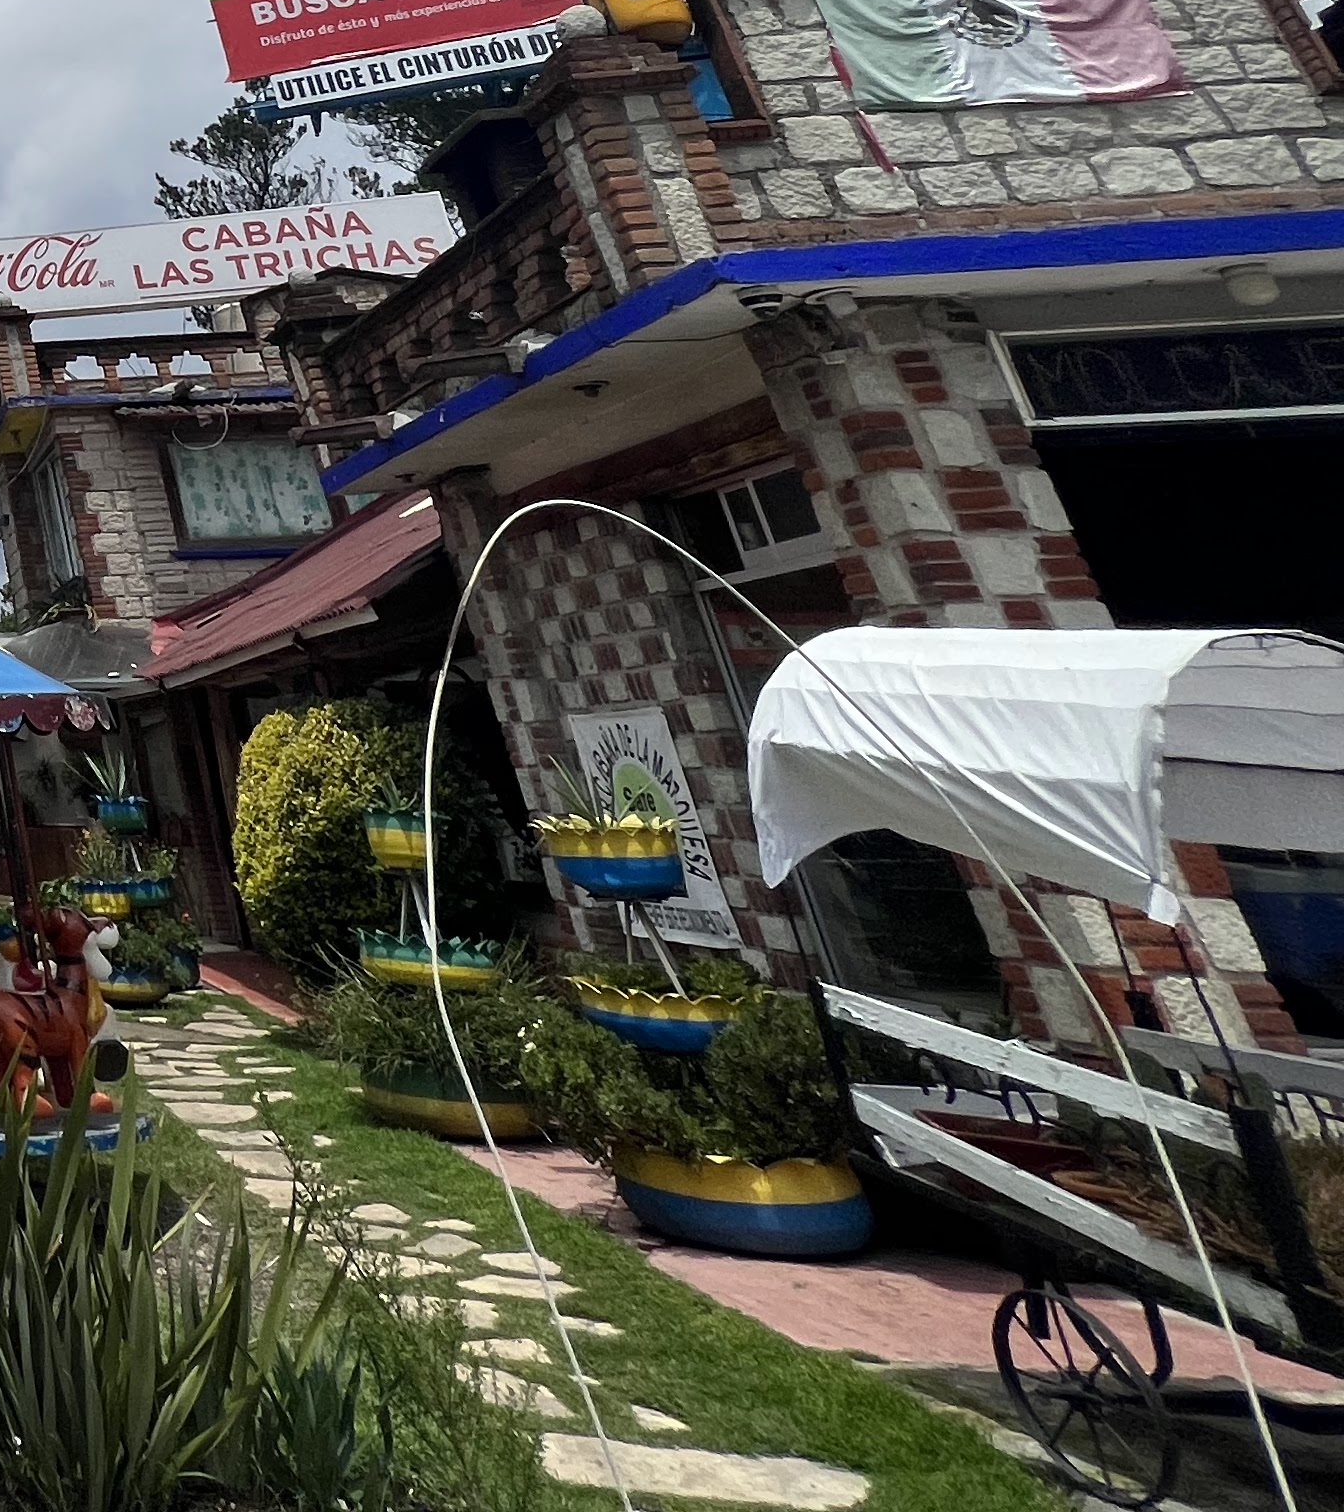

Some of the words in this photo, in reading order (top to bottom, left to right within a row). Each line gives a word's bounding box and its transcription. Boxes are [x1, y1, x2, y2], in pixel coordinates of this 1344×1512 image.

[317, 21, 335, 36] de
[370, 15, 380, 29] y
[276, 63, 365, 102] UTILICE
[368, 61, 395, 85] EL
[398, 33, 527, 80] CINTURÓN
[181, 206, 372, 252] CABAÑA
[133, 258, 214, 289] LAS
